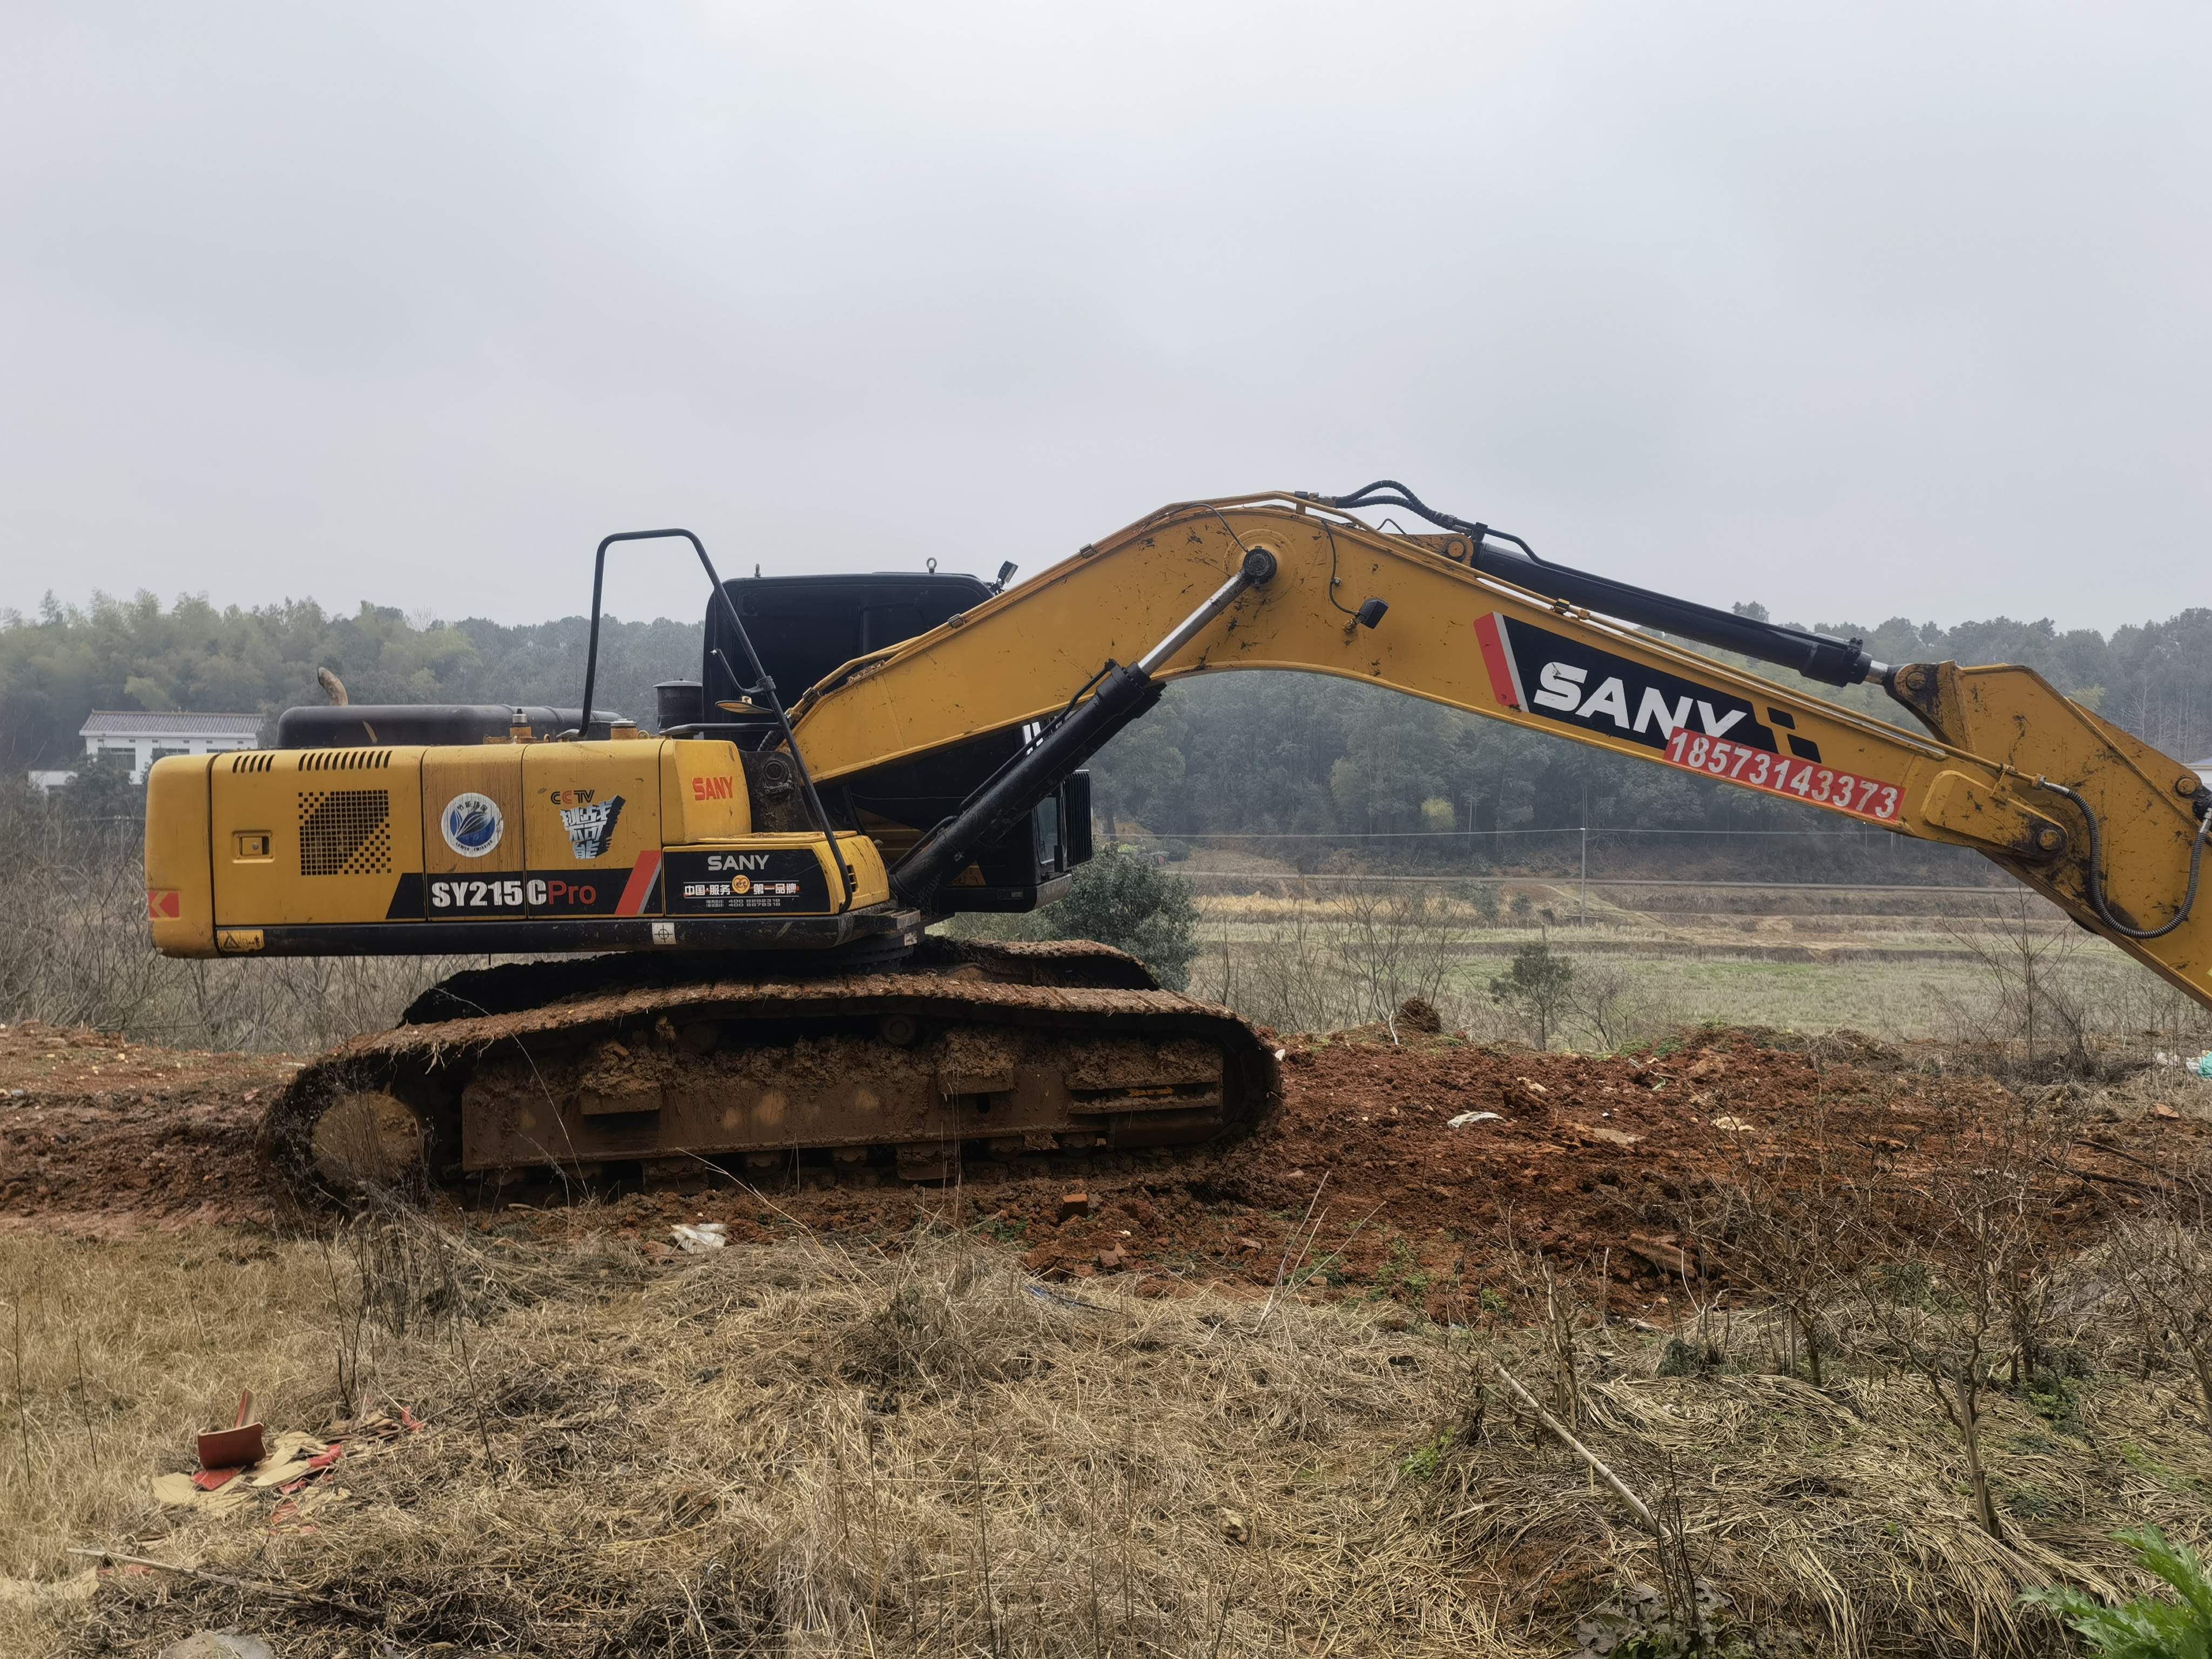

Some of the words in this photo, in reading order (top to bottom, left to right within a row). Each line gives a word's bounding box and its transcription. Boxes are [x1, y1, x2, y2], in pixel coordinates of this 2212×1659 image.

[1534, 662, 1748, 740] SANY
[1671, 732, 1898, 818] 18573143373
[550, 790, 595, 805] CCTV
[692, 776, 733, 801] SANY
[707, 855, 770, 871] SANY
[753, 883, 797, 895] 第一品牌
